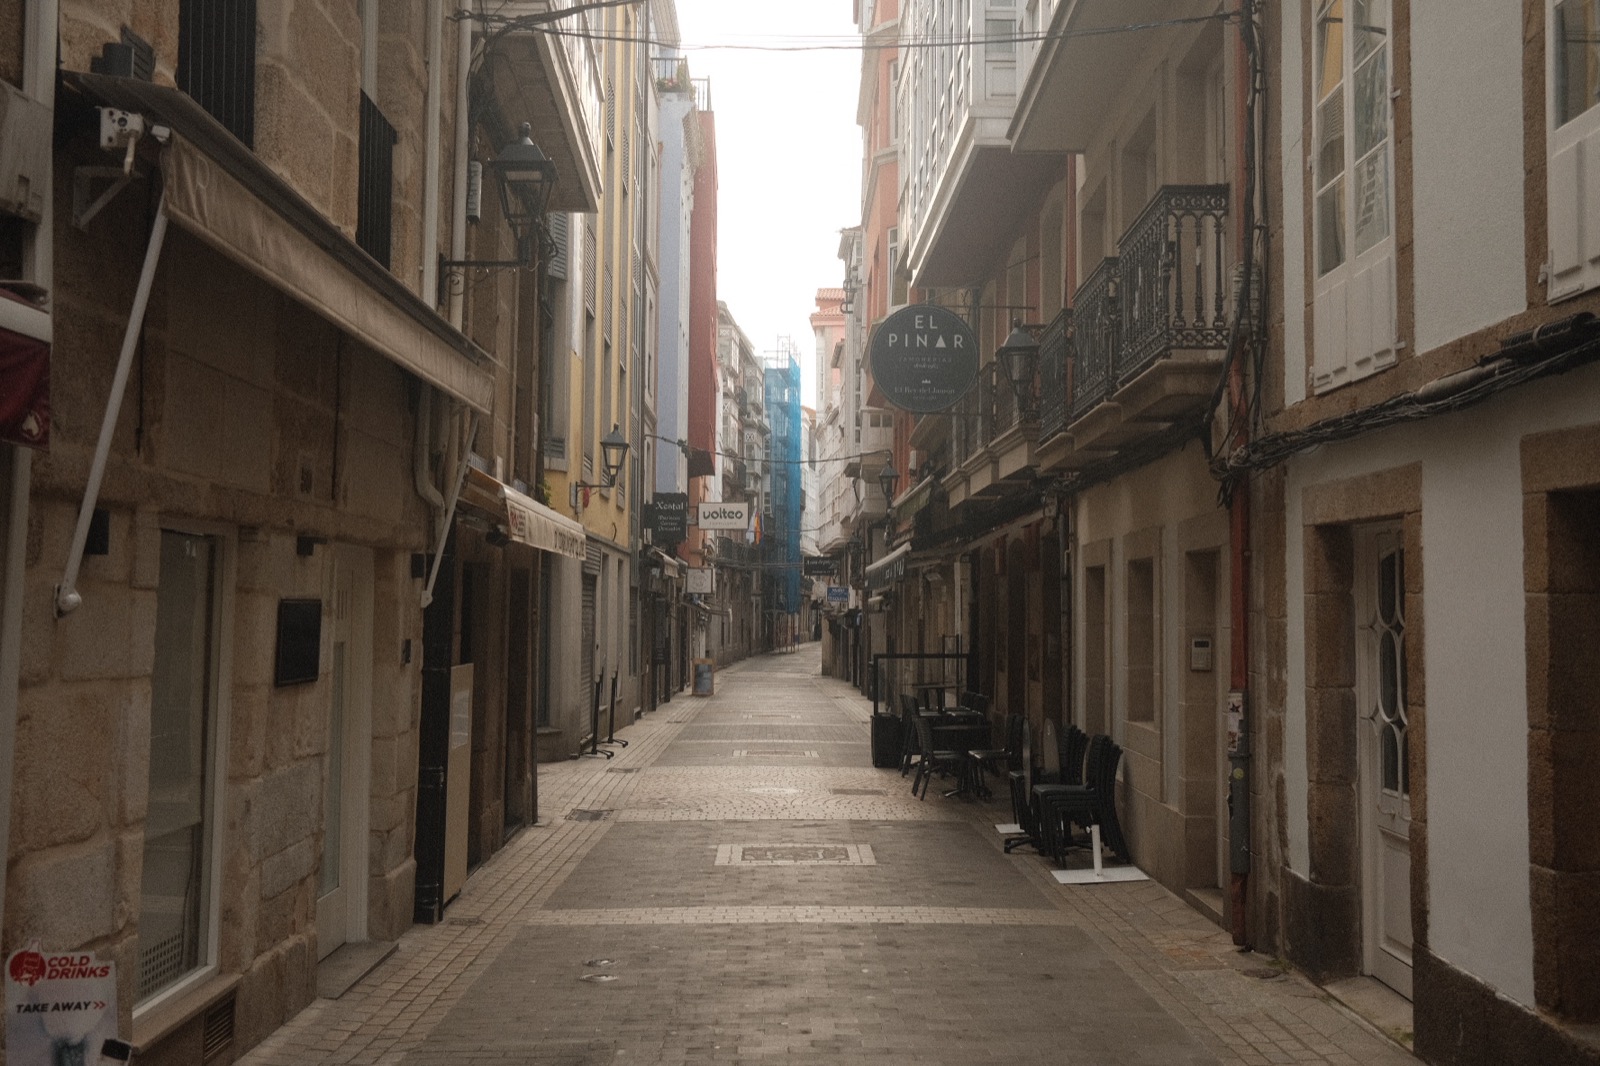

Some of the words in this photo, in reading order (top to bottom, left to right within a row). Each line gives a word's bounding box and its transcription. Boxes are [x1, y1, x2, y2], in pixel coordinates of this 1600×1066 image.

[915, 315, 937, 329] EL
[888, 333, 964, 349] PINAR
[655, 501, 684, 511] Xestal
[703, 507, 743, 519] volteo
[48, 956, 90, 967] COLD
[47, 966, 110, 979] DRINKS
[16, 1003, 49, 1013] TAKE
[51, 1001, 91, 1011] AWAY
